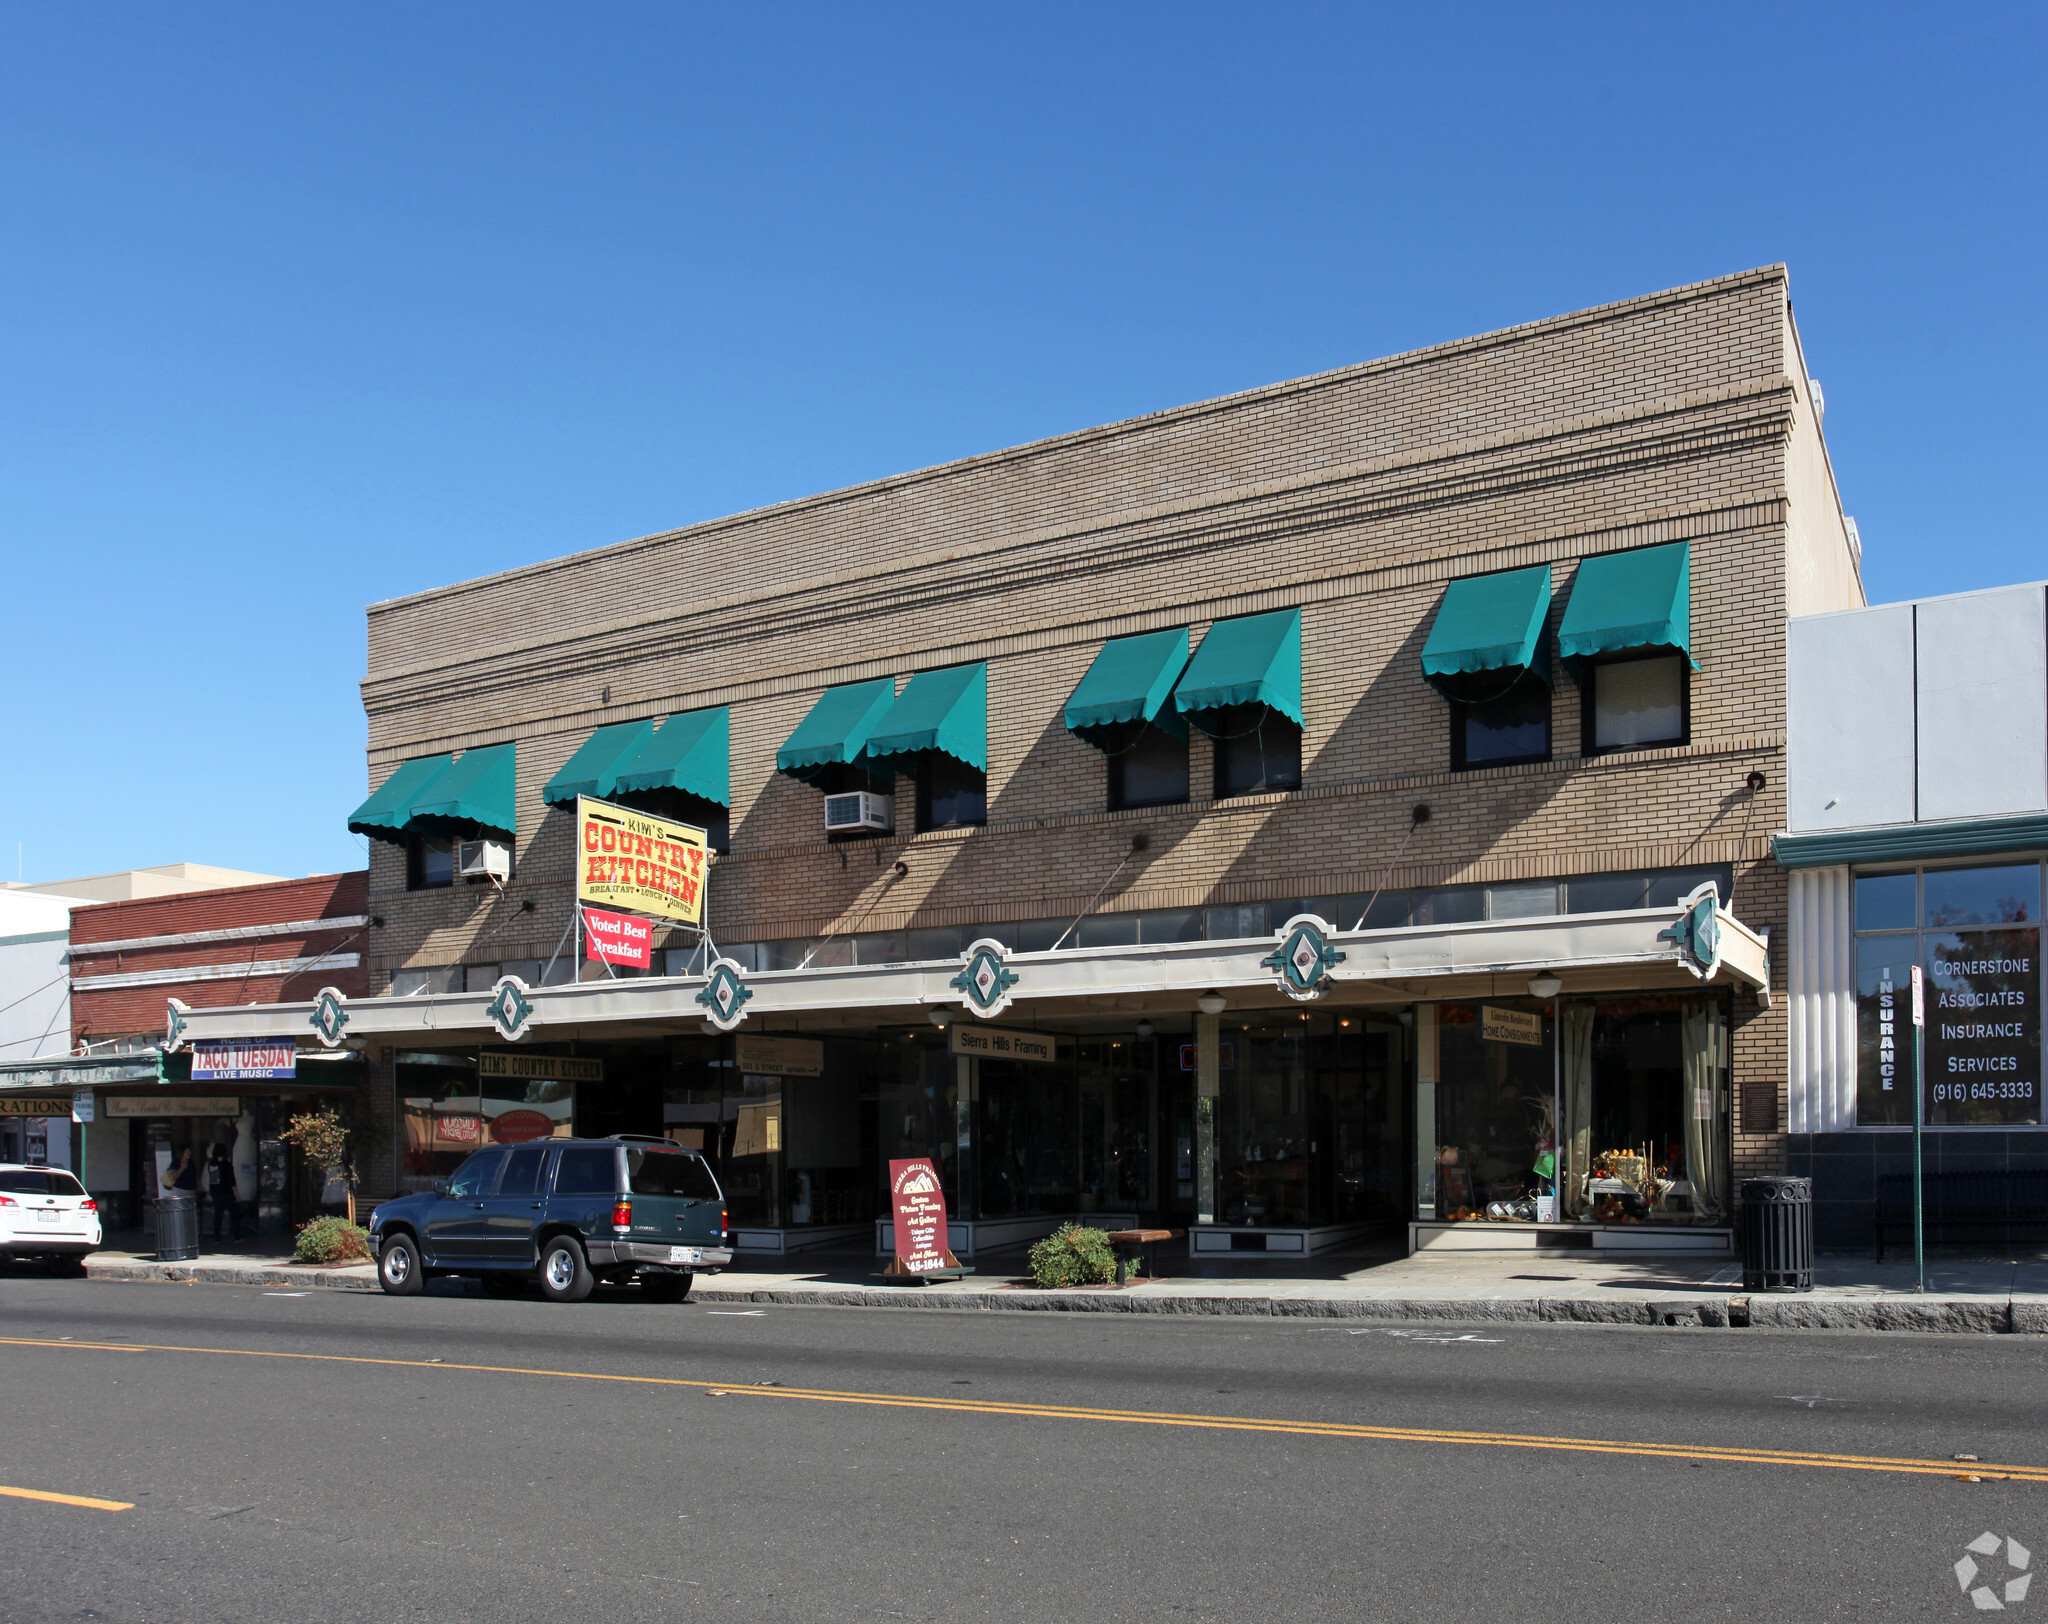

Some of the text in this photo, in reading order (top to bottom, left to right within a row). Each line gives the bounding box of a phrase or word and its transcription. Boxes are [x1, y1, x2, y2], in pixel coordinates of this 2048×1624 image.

[628, 818, 664, 839] KIM'S
[585, 821, 704, 878] COUNTRY
[585, 856, 698, 907] KITCHEN
[589, 885, 692, 915] BREAKFAST LUNCH DINNER
[590, 916, 647, 939] Voted Best
[593, 938, 643, 959] Breakfast
[1934, 958, 2030, 976] CORNERSTONE
[1938, 991, 2025, 1008] ASSOCIATES
[1491, 1010, 1533, 1026] Lincoln Boulevard
[1483, 1022, 1540, 1043] HOME CONSIGNMENTS
[1879, 967, 1895, 1091] INSURANCE
[1941, 1023, 2023, 1040] INSURANCE
[961, 1032, 1047, 1058] Sierra Hills Framing
[196, 1045, 295, 1069] TACO TUESDAY
[480, 1055, 602, 1078] KIMS COUNTRY KITCHEN
[761, 1063, 782, 1071] STREET
[1948, 1056, 2017, 1072] SERVICES
[213, 1069, 274, 1079] LIVE MUSIC
[1933, 1081, 2033, 1103] (916) 645-3333
[0, 1101, 72, 1113] RATIONS
[894, 1170, 908, 1194] SIERRA
[907, 1163, 922, 1174] HILLS
[900, 1203, 941, 1213] Picture Framing
[911, 1196, 929, 1205] Custom
[907, 1216, 937, 1226] Art Gallery
[909, 1251, 923, 1260] And
